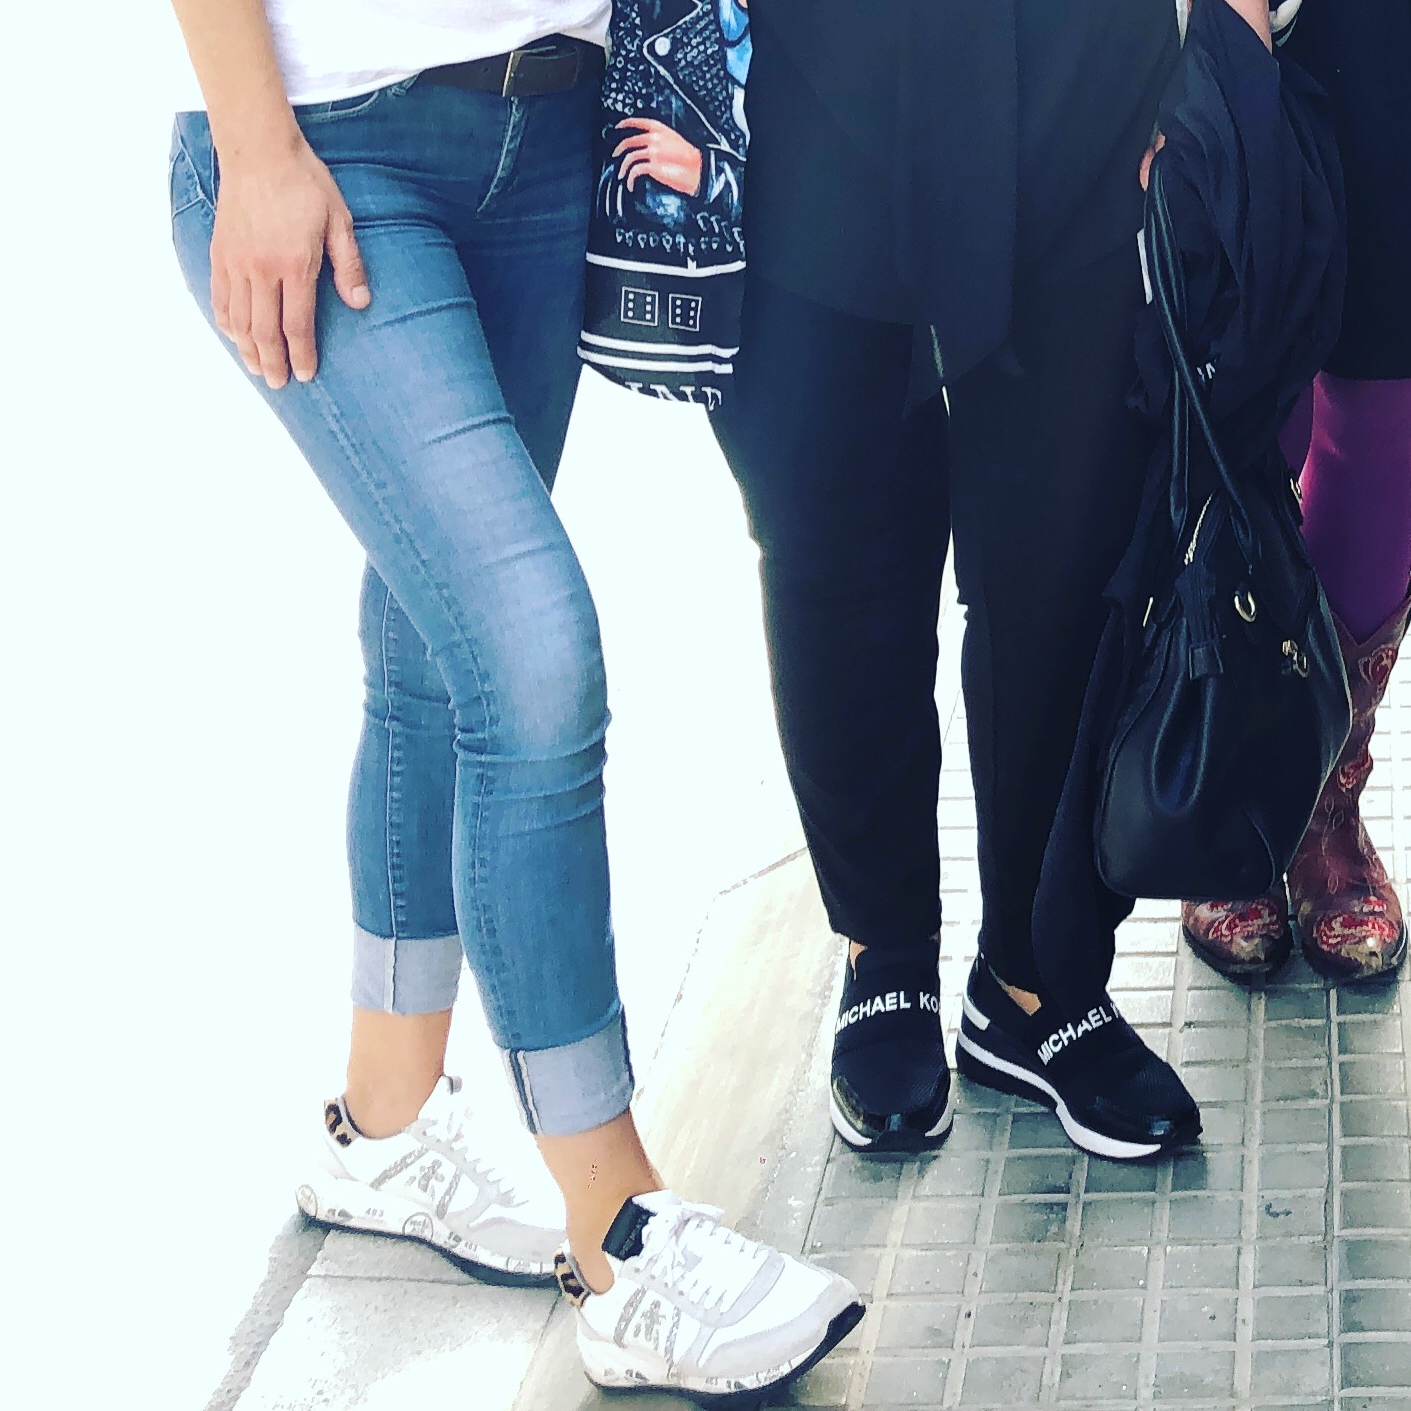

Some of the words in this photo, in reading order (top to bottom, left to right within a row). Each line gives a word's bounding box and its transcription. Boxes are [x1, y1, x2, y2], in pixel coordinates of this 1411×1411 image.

[835, 991, 911, 1035] MICHAEL
[919, 991, 941, 1019] KO
[1037, 1005, 1112, 1066] MICHAEL
